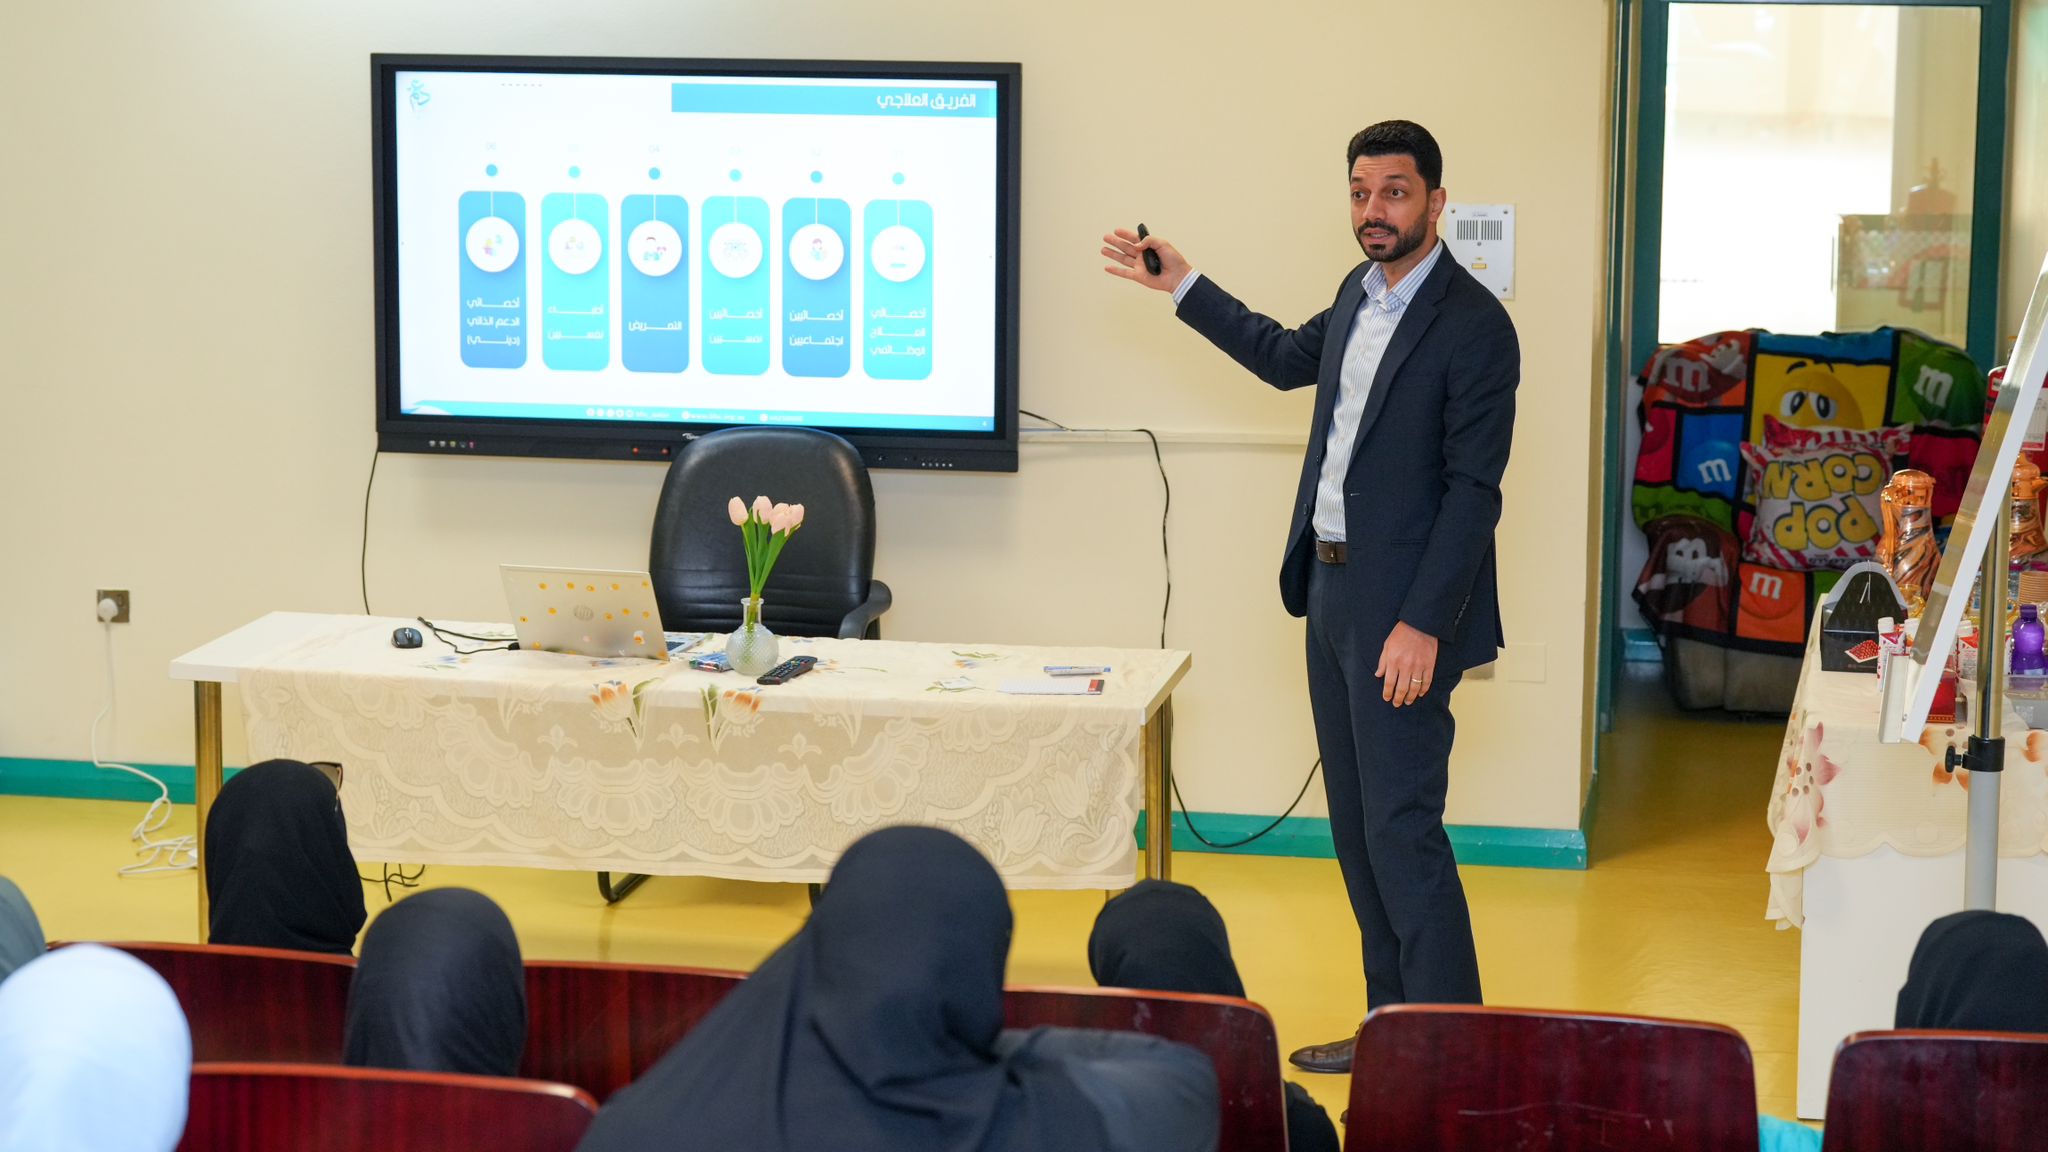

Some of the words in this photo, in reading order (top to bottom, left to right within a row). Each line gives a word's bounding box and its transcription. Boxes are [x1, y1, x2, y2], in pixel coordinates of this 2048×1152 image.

[876, 92, 929, 109] العلاجي
[930, 92, 977, 110] الفريق
[1913, 364, 1954, 408] m
[1697, 458, 1732, 484] m
[1763, 453, 1884, 502] CORN
[1773, 495, 1879, 551] POP
[1748, 572, 1784, 600] m
